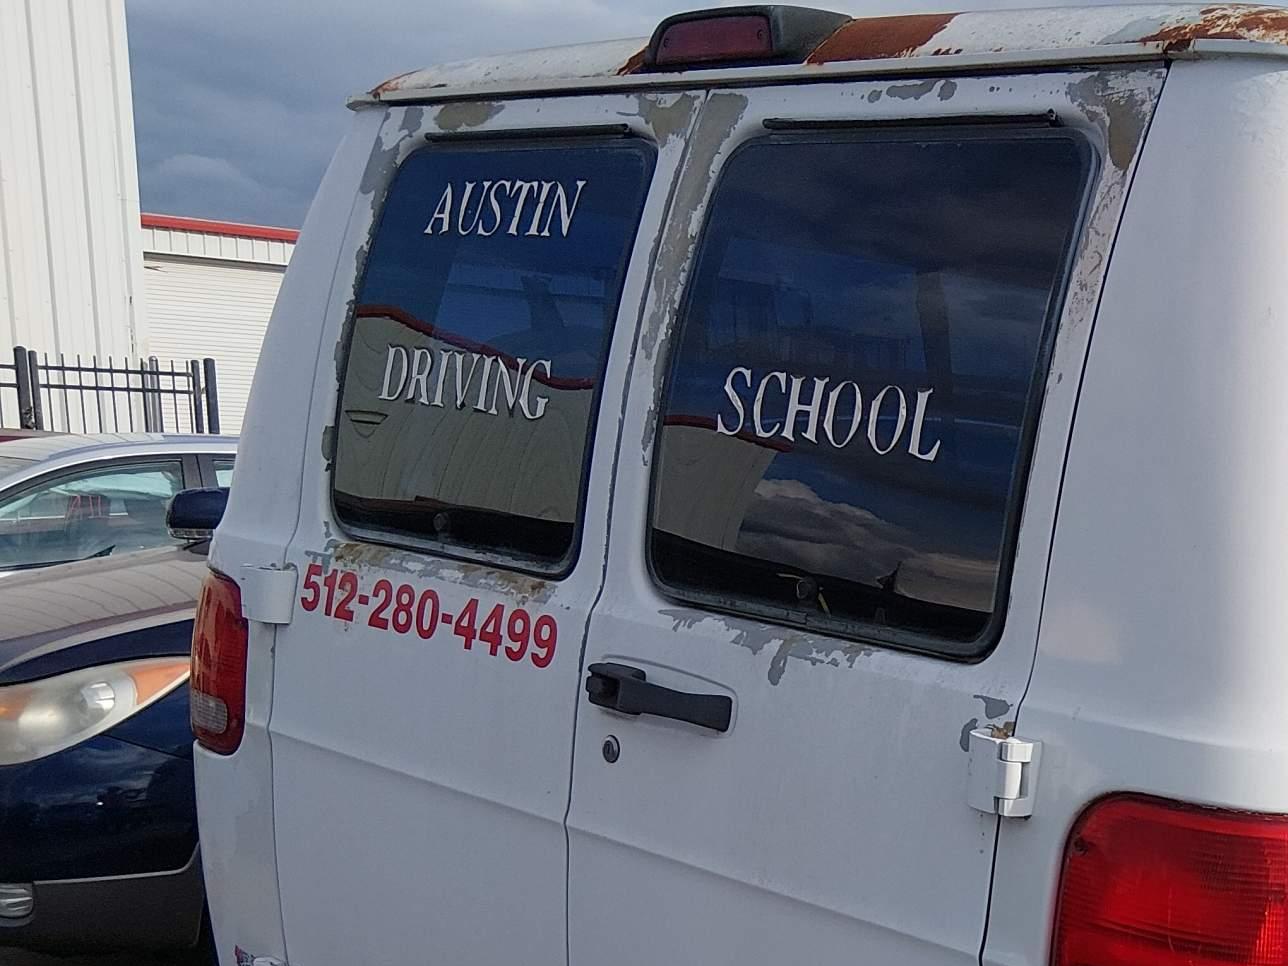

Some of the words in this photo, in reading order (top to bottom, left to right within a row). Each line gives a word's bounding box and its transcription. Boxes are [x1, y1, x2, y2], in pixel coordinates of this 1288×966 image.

[424, 180, 587, 237] AUSTIN
[378, 344, 552, 420] DRIVING
[716, 366, 942, 462] SCHOOL
[300, 562, 558, 669] 512-280-4499
